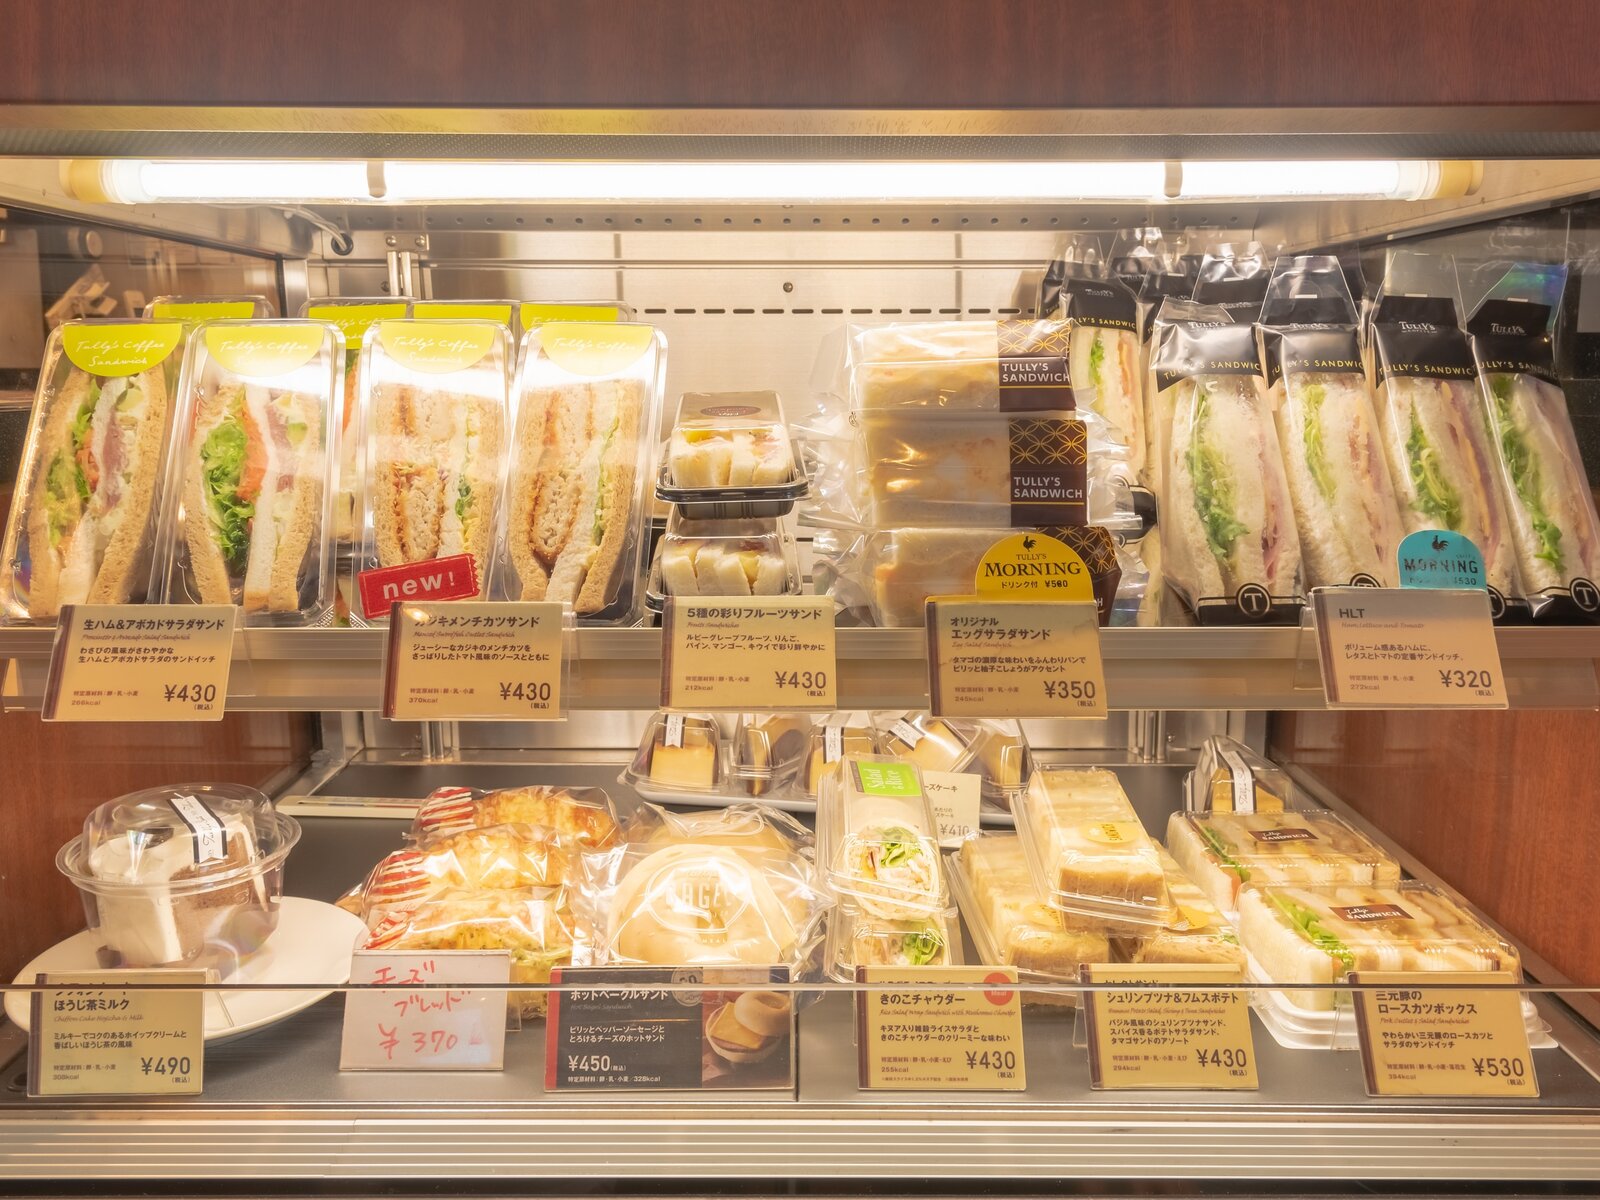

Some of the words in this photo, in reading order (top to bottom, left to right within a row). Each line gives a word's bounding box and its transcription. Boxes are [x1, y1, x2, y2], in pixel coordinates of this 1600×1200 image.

[1098, 318, 1137, 330] SANDWIC
[76, 340, 120, 355] Tully's
[123, 339, 165, 352] Coffee
[88, 356, 148, 367] Sandwich
[1210, 361, 1261, 371] SANDWIC
[1314, 359, 1364, 369] SANDWIC
[1002, 363, 1048, 372] TULLY'S
[1424, 364, 1473, 376] SANDWIC
[1518, 362, 1559, 379] SANDWIC
[1002, 373, 1070, 382] SANDWICH
[1014, 476, 1060, 486] TULLY'S
[1014, 488, 1082, 498] SANDWICH
[985, 561, 1081, 577] MORNING
[383, 572, 455, 600] new!
[687, 608, 822, 619] 5種の彩りフルーツサンド
[1339, 608, 1365, 619] HLT
[84, 619, 225, 630] 生ハム&アボカドサラダサンド
[950, 617, 999, 626] オリジナル
[686, 634, 800, 642] ルビーグレープフルーツ、りんご、
[951, 629, 1051, 640] エッグサラダサンド
[953, 656, 1085, 664] タマゴの濃厚な味わいをふんわりパンで
[775, 671, 826, 688] ¥430
[1439, 670, 1491, 688] ¥320
[164, 684, 216, 702] ¥430
[500, 682, 550, 700] ¥430
[1044, 681, 1095, 699] ¥350
[924, 784, 958, 792] ーズケーキ
[1346, 911, 1401, 920] SANDWICH
[880, 994, 965, 1005] きのこチャウダー
[1107, 992, 1239, 1004] シュリンプツナ&フムスポテト
[1376, 991, 1422, 1001] 三元豚の
[54, 999, 129, 1011] ほうじ茶ミルク
[1378, 1003, 1477, 1014] ロースカツボックス
[54, 1031, 187, 1039] ミルキーでコクのあるホイップクリームと
[570, 1025, 665, 1034] ピリッとペッパーソーセージと
[569, 1034, 665, 1043] とろけるチーズのホットサンド
[881, 1034, 1010, 1042] きのこチャウダーのクリーミーな味わい
[54, 1041, 133, 1049] 香ばしいほうじ茶の風味
[568, 1055, 610, 1072] ¥450
[966, 1051, 1015, 1069] ¥430
[1197, 1049, 1246, 1067] ¥430
[141, 1057, 190, 1075] ¥490
[1472, 1058, 1524, 1077] ¥530
